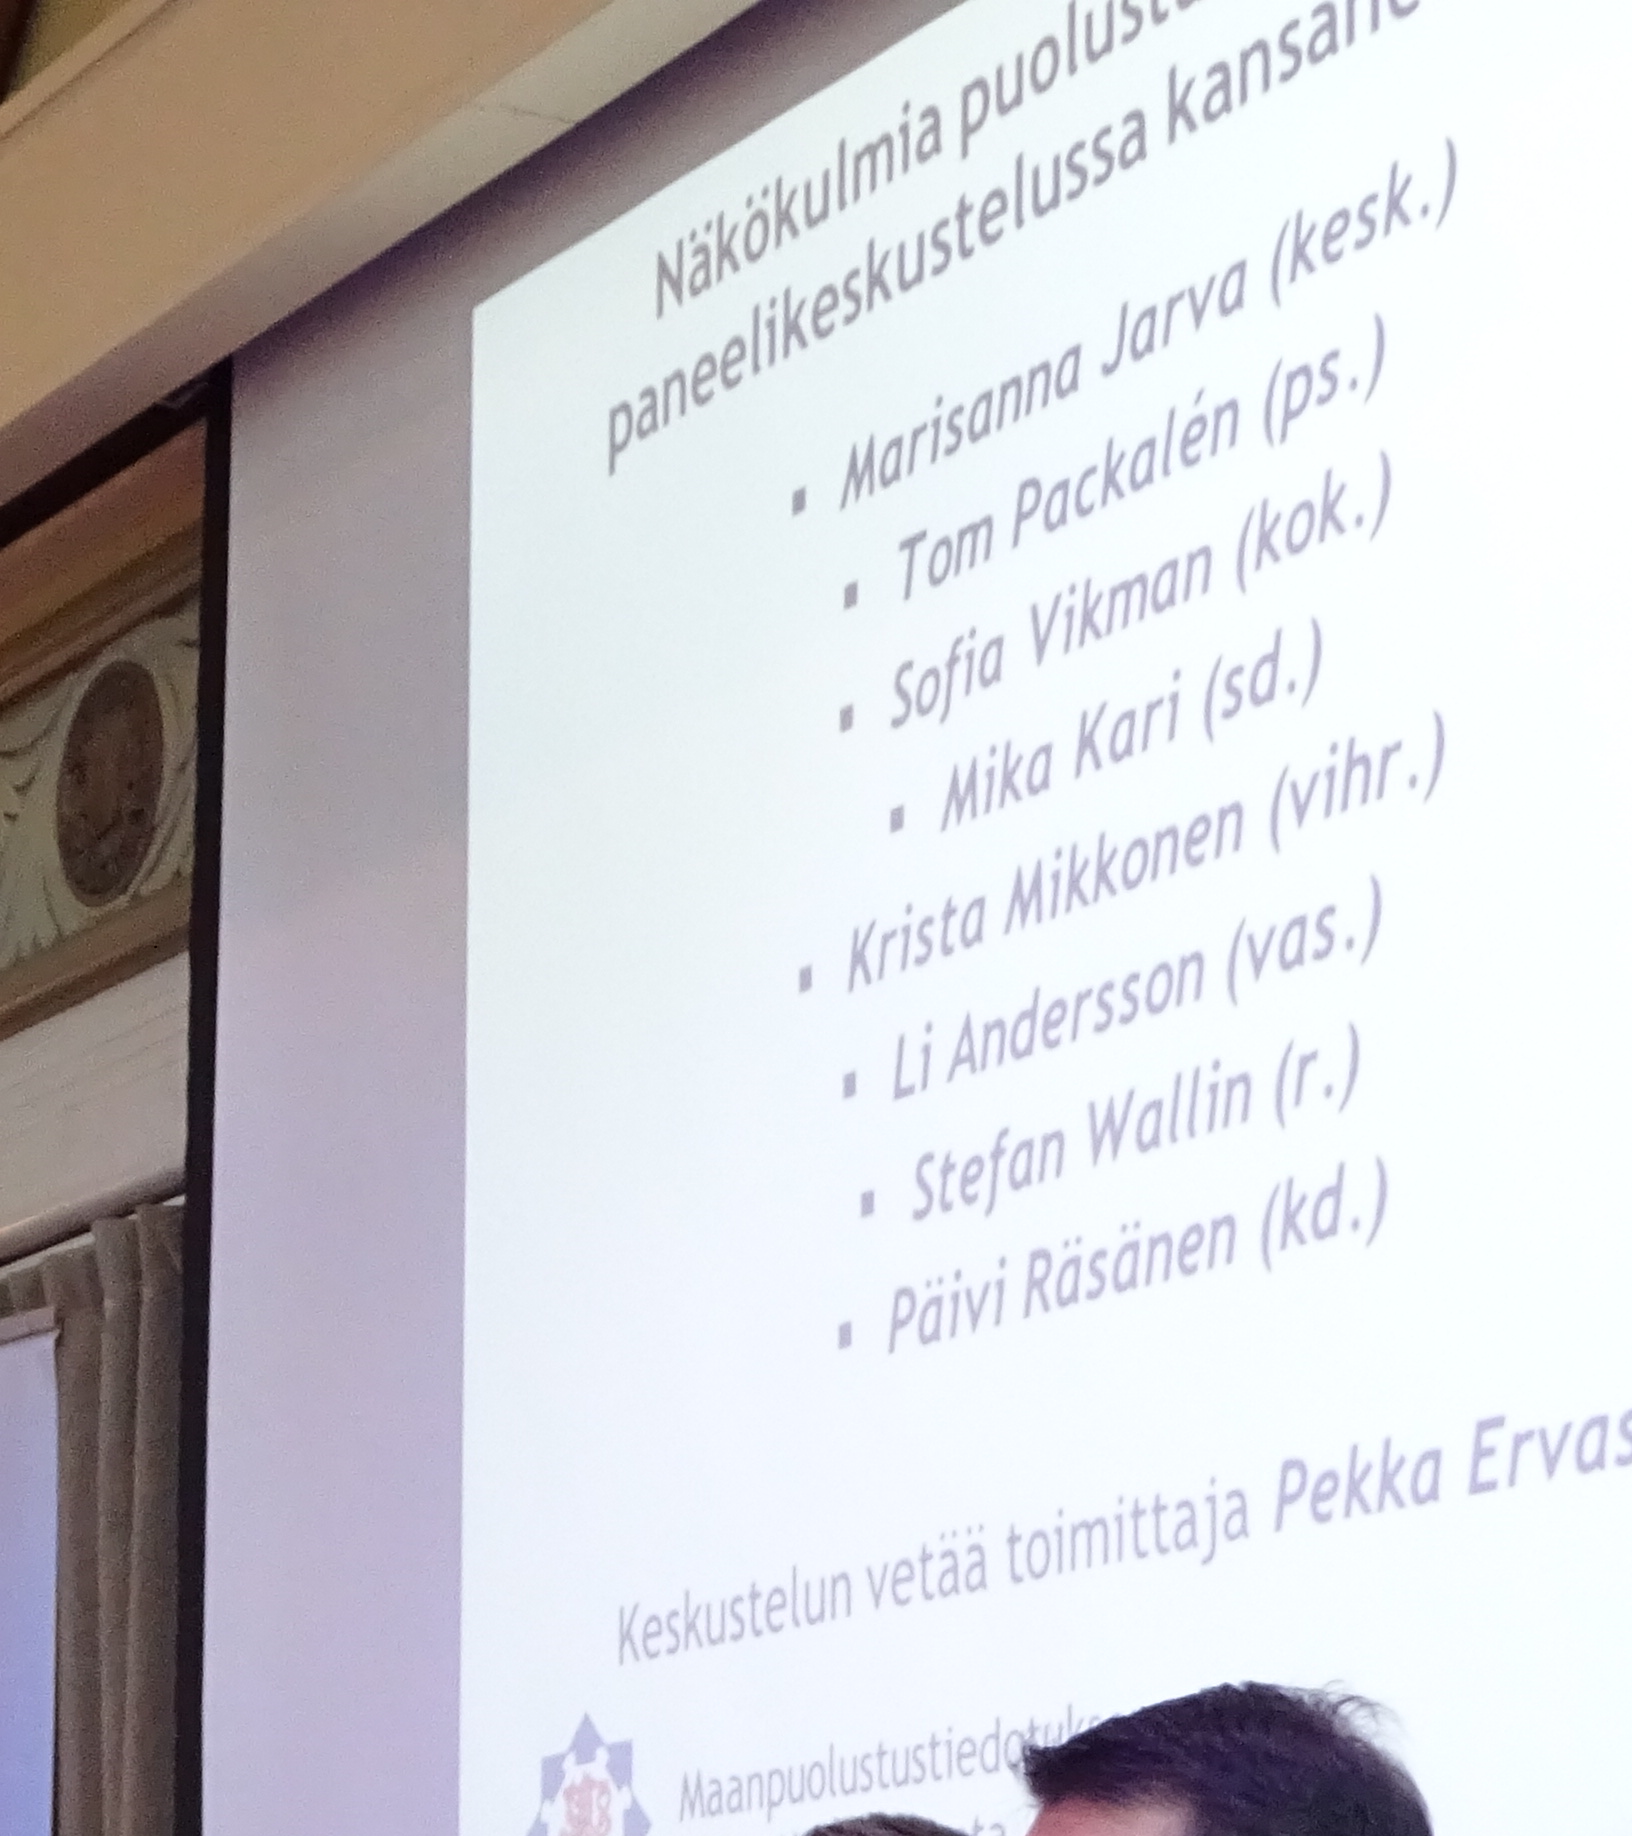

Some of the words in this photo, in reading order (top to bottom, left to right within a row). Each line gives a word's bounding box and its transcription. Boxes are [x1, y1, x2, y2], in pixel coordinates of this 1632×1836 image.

[607, 106, 1148, 475] paneelikeskustelussa
[652, 101, 944, 320] Näkökulmia
[959, 0, 1201, 156] puolus
[839, 343, 1084, 510] Marisanna
[1100, 258, 1248, 377] Jarva
[1270, 137, 1458, 308] (kesk.)
[897, 513, 994, 601] Tom
[1011, 386, 1240, 550] Packalén
[1263, 311, 1386, 449] (ps.)
[890, 626, 1005, 730] Sofia
[1029, 542, 1214, 667] Vikman
[1235, 449, 1392, 596] (kok.)
[939, 739, 1054, 833] Mika
[1074, 667, 1182, 780] Kari
[1202, 616, 1324, 744] (sd.)
[847, 894, 986, 993] Krista
[1003, 797, 1244, 936] Mikkonen
[1269, 708, 1447, 854] (vihr.)
[892, 1020, 933, 1101] Li
[945, 949, 1207, 1084] Andersson
[1226, 873, 1383, 1007] (vas.)
[887, 1255, 1008, 1355] Päivi
[1022, 1211, 1238, 1320] Räsänen
[1259, 1154, 1389, 1274] (kd.)
[911, 1125, 1067, 1222] Stefan
[1087, 1057, 1253, 1168] Wallin
[1273, 1020, 1362, 1129] (r.)
[617, 1564, 853, 1667] Keskustelun
[866, 1523, 989, 1612] vetää
[1005, 1476, 1250, 1585] toimittaja
[1273, 1435, 1443, 1533] Pekka
